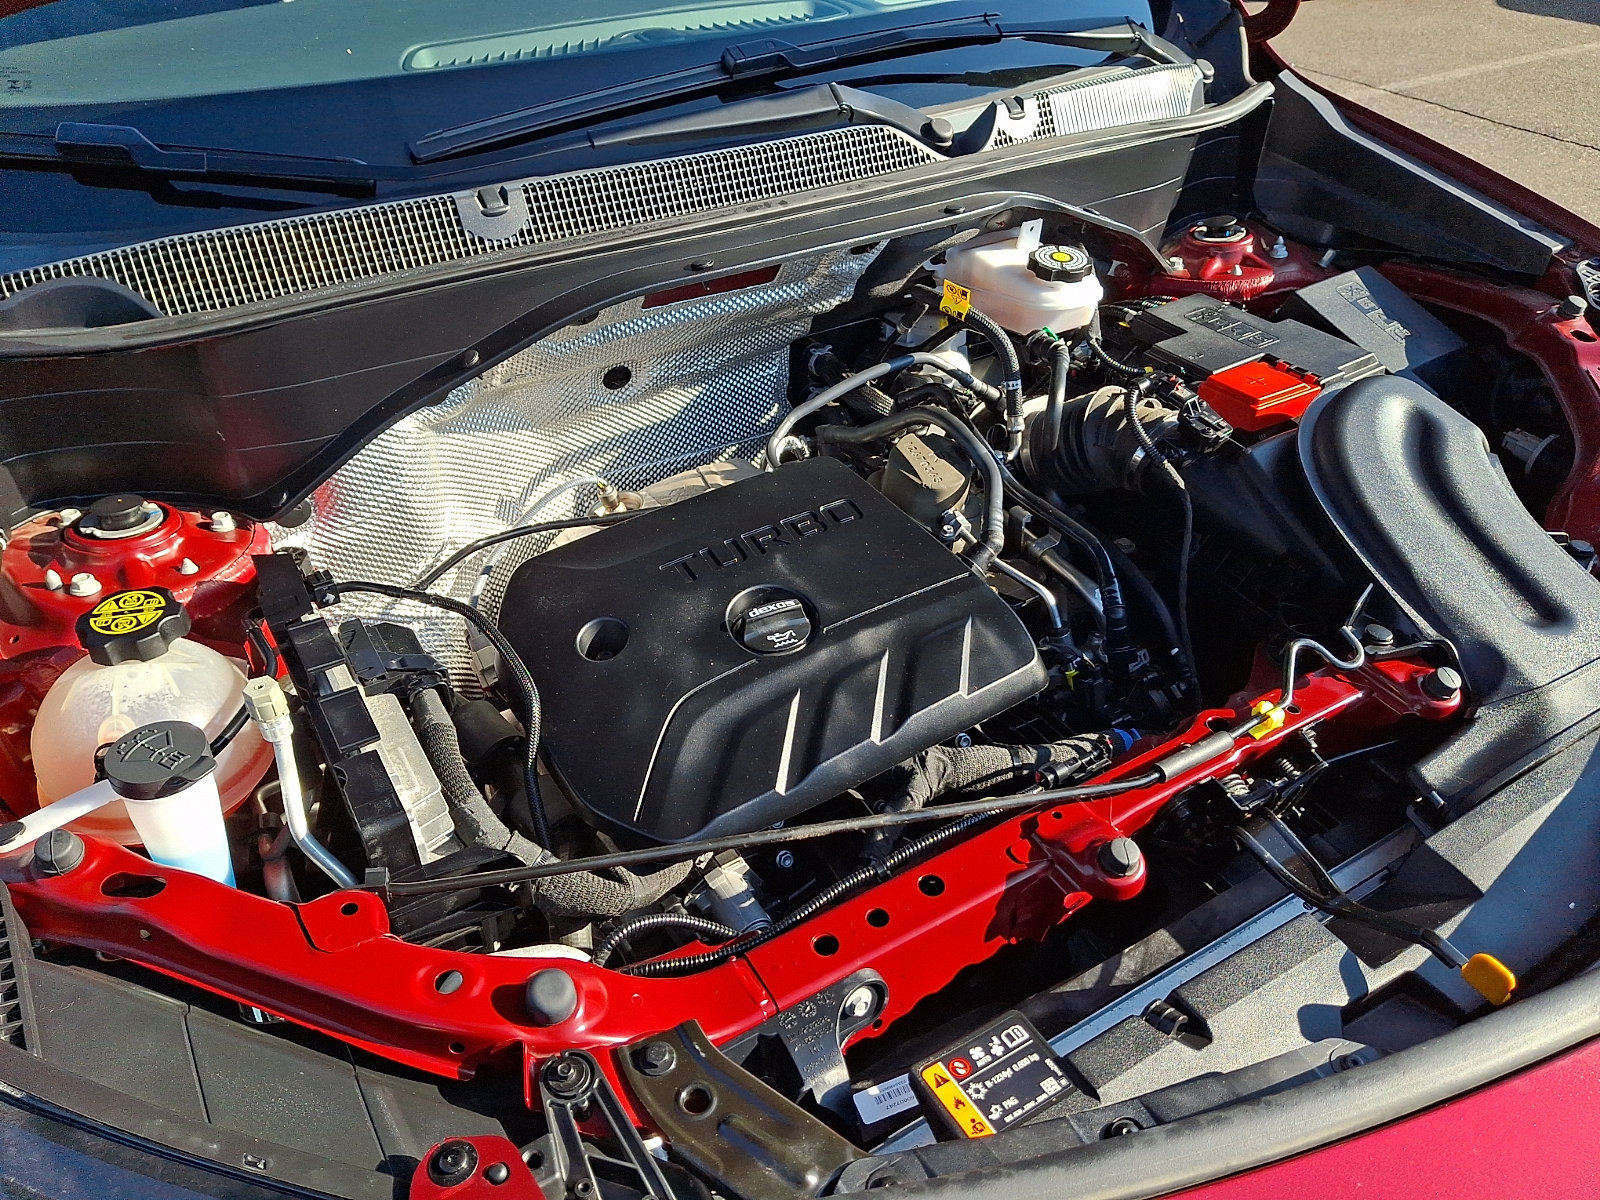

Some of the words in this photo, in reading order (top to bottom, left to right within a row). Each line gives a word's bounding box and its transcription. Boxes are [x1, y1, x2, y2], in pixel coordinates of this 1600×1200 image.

[658, 498, 864, 582] TURBO
[748, 600, 796, 618] dexos
[976, 1055, 992, 1068] AUTO
[1002, 1096, 1019, 1110] PAG
